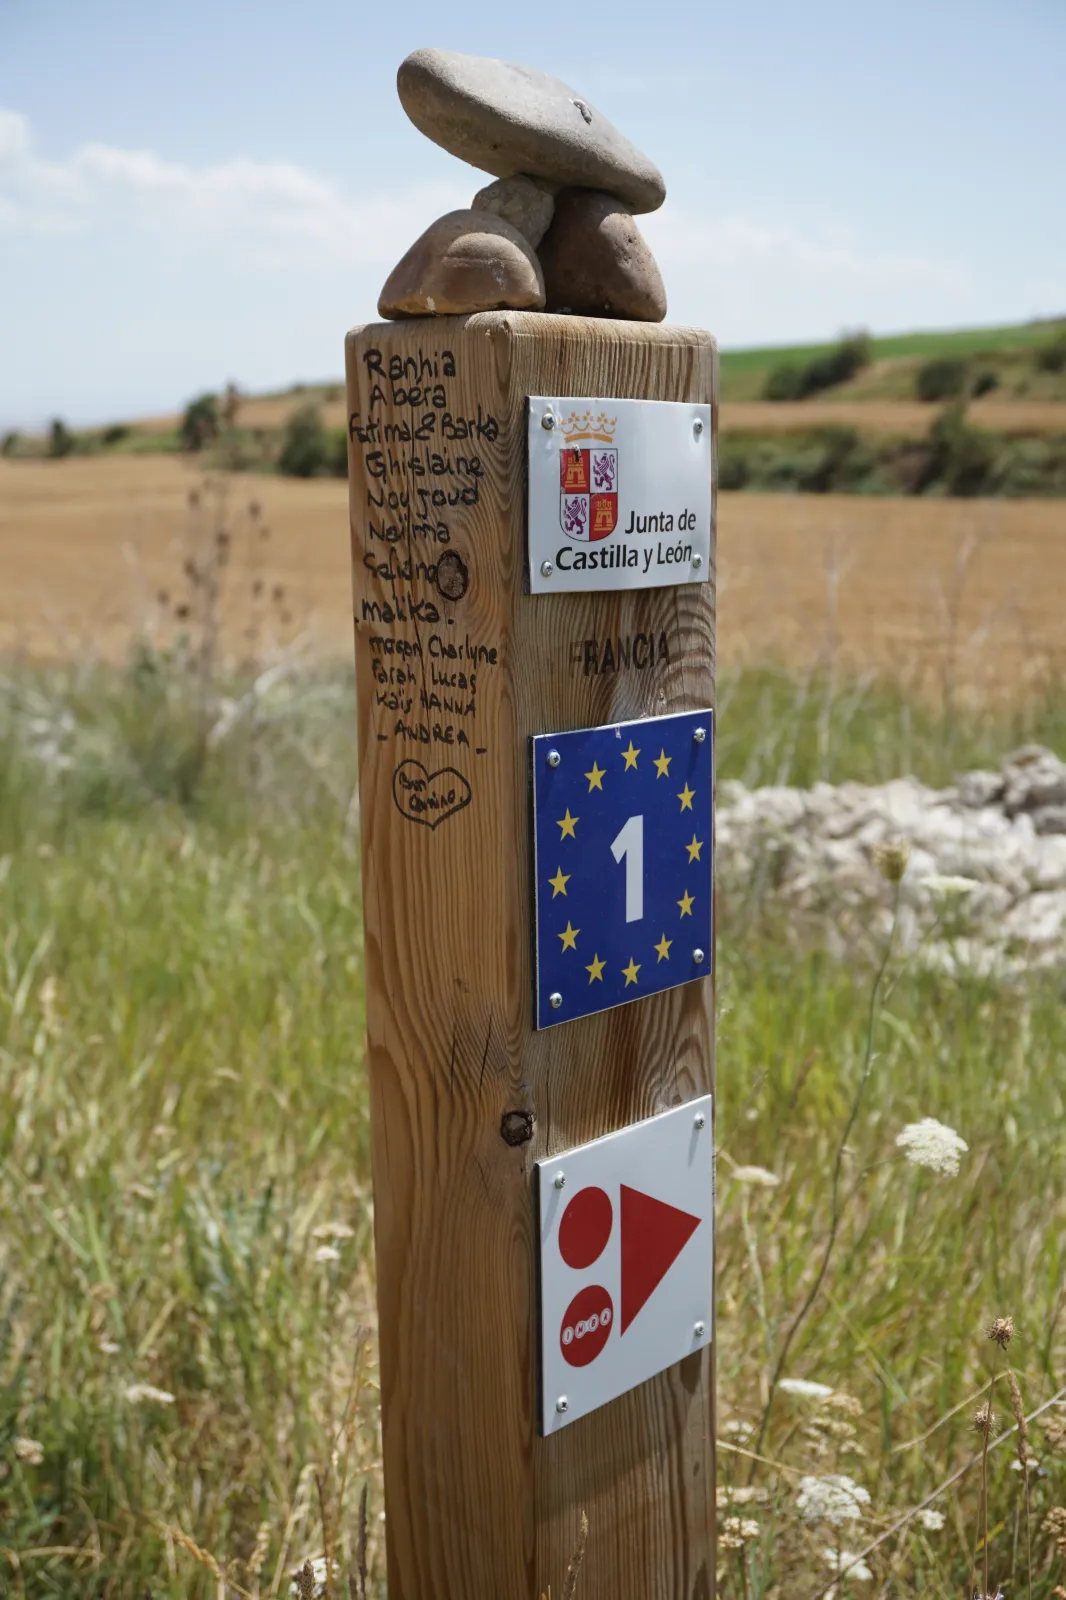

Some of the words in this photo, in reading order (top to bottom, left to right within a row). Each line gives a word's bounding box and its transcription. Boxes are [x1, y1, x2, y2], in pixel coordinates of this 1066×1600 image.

[362, 347, 457, 385] Ranhia
[365, 446, 484, 484] Ghislaine
[624, 510, 674, 535] Junta
[677, 508, 697, 531] de
[555, 544, 639, 571] Castilla
[642, 548, 654, 574] y
[656, 540, 693, 565] León
[569, 631, 671, 678] FRANCIA
[430, 662, 478, 695] Lucas
[610, 814, 644, 924] 1
[563, 1309, 610, 1343] IMBA
